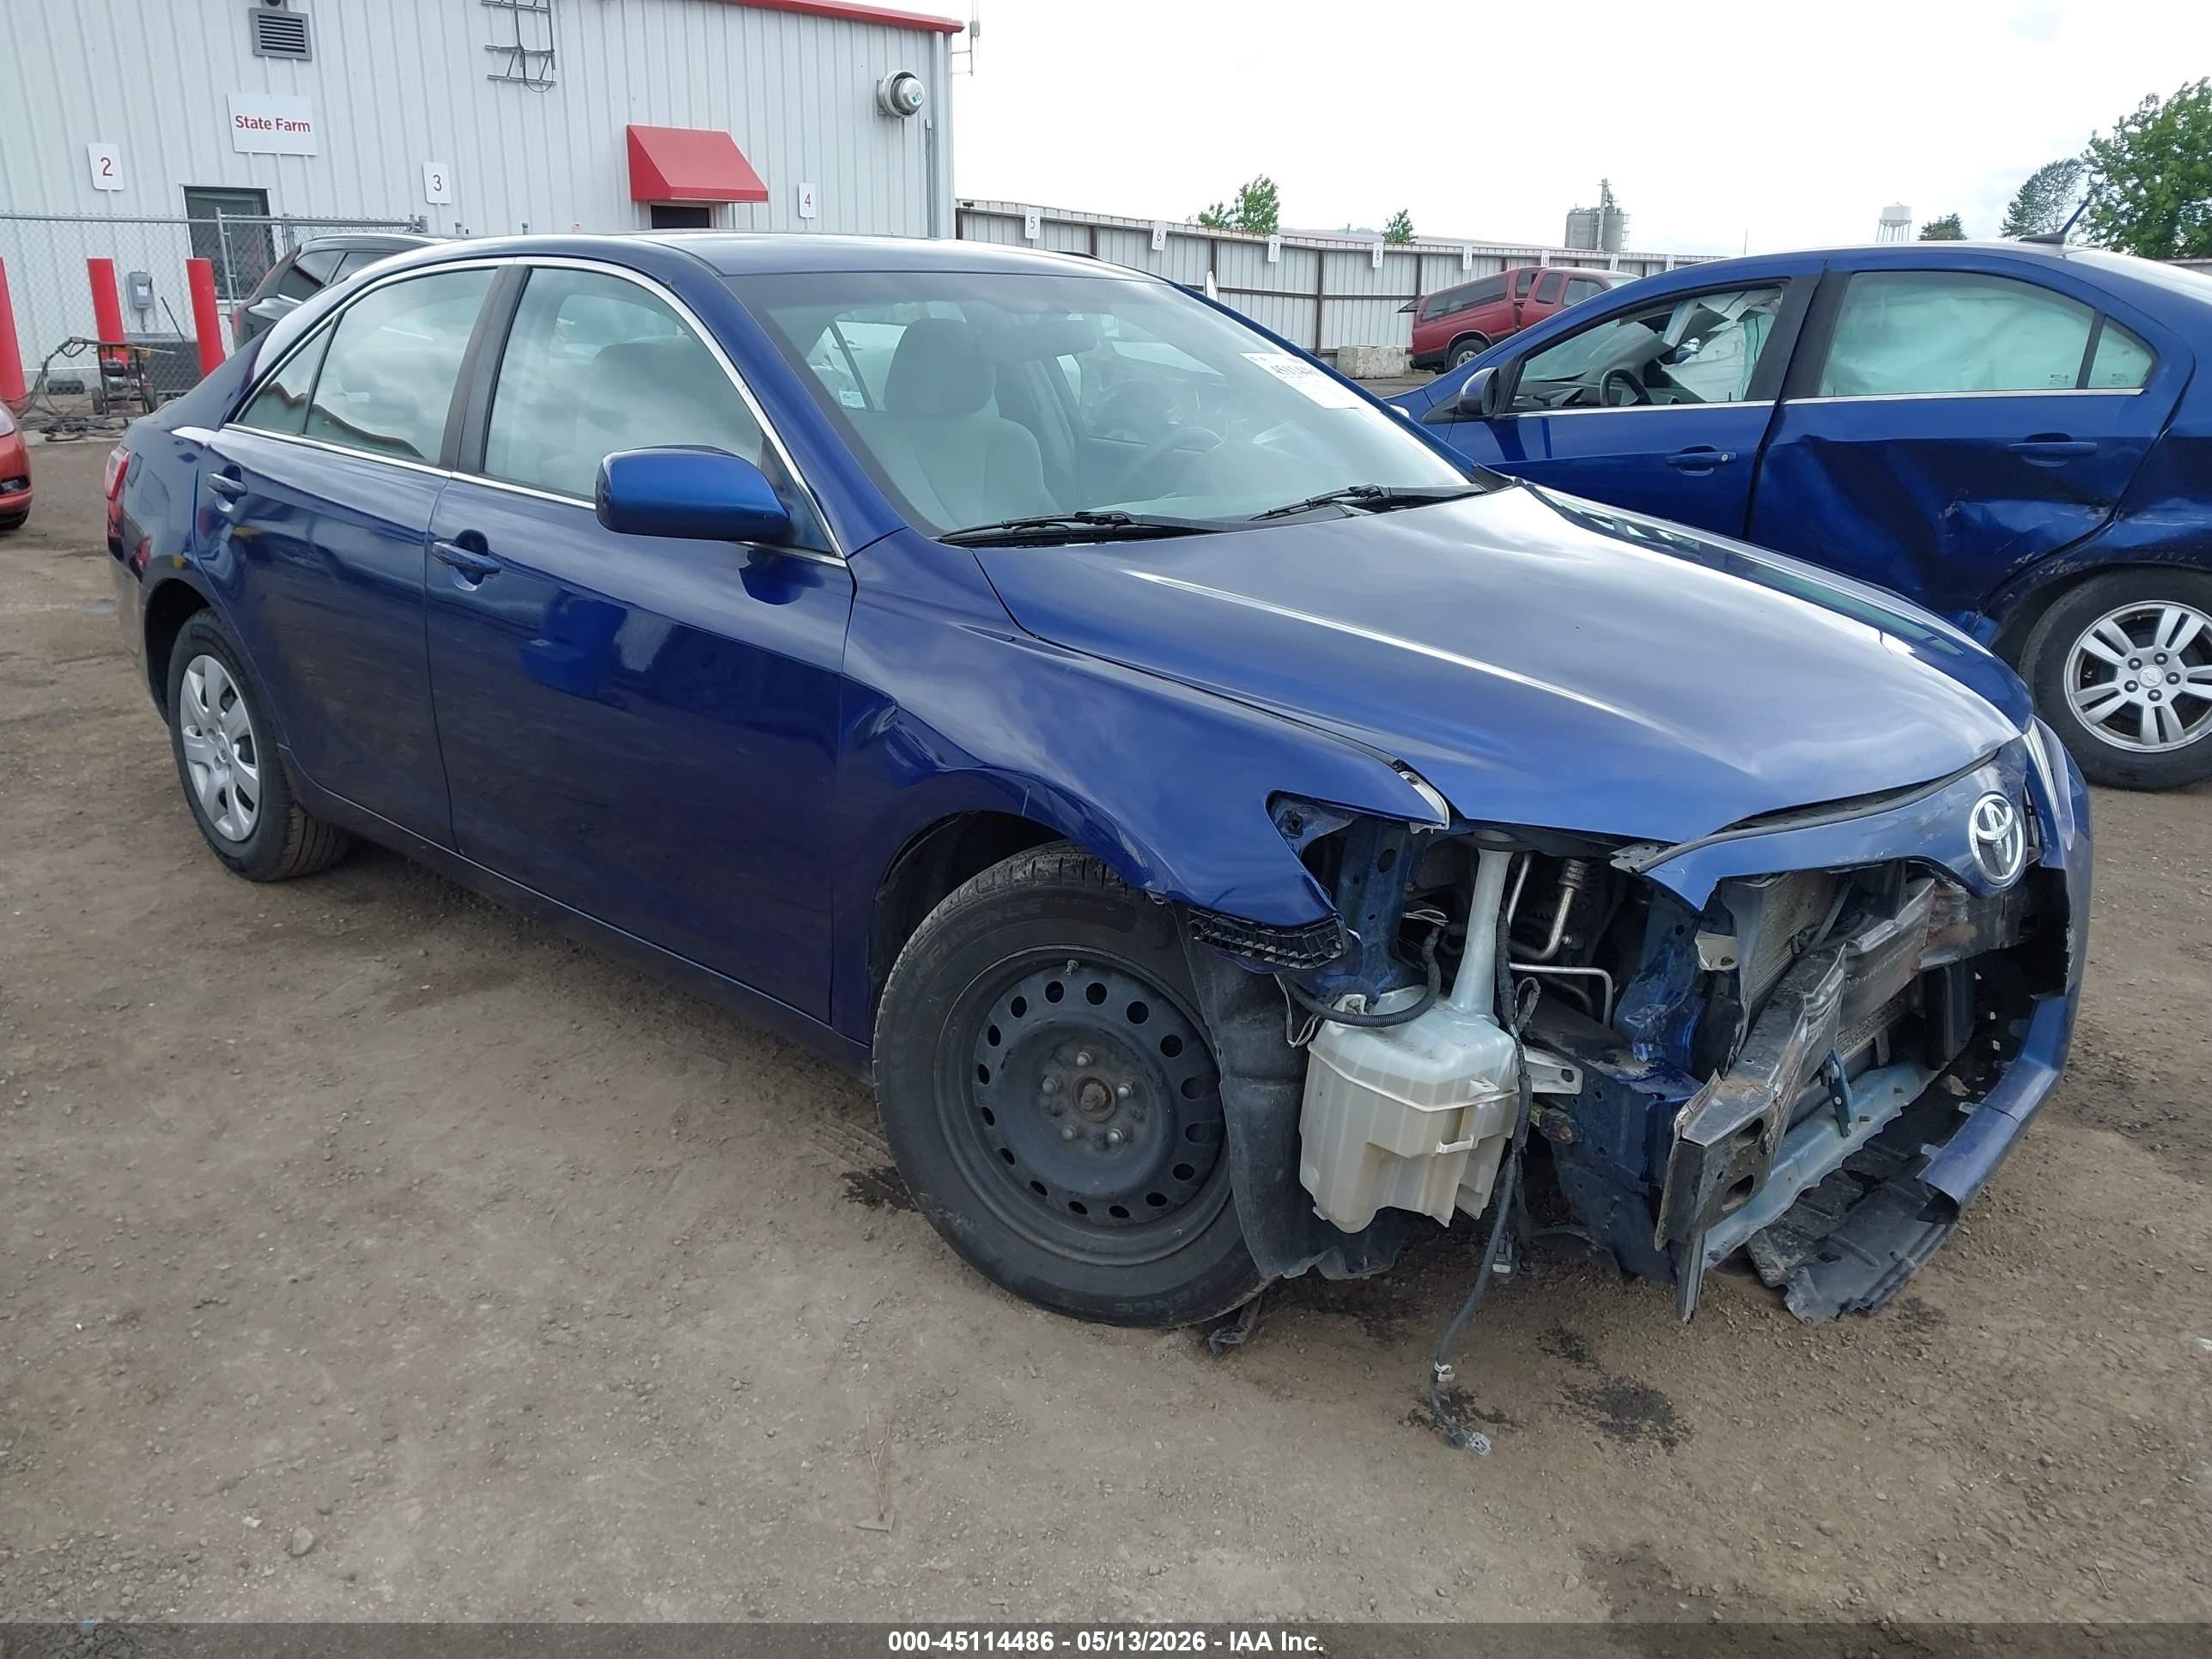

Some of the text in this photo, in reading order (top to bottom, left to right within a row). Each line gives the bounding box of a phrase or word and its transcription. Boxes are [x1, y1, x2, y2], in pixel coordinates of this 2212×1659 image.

[234, 115, 311, 132] State Farm
[100, 157, 113, 177] 2
[433, 174, 442, 191] 3
[804, 193, 811, 207] 4
[1030, 216, 1036, 229] 5
[1156, 230, 1162, 242] 6
[1272, 242, 1278, 254] 7
